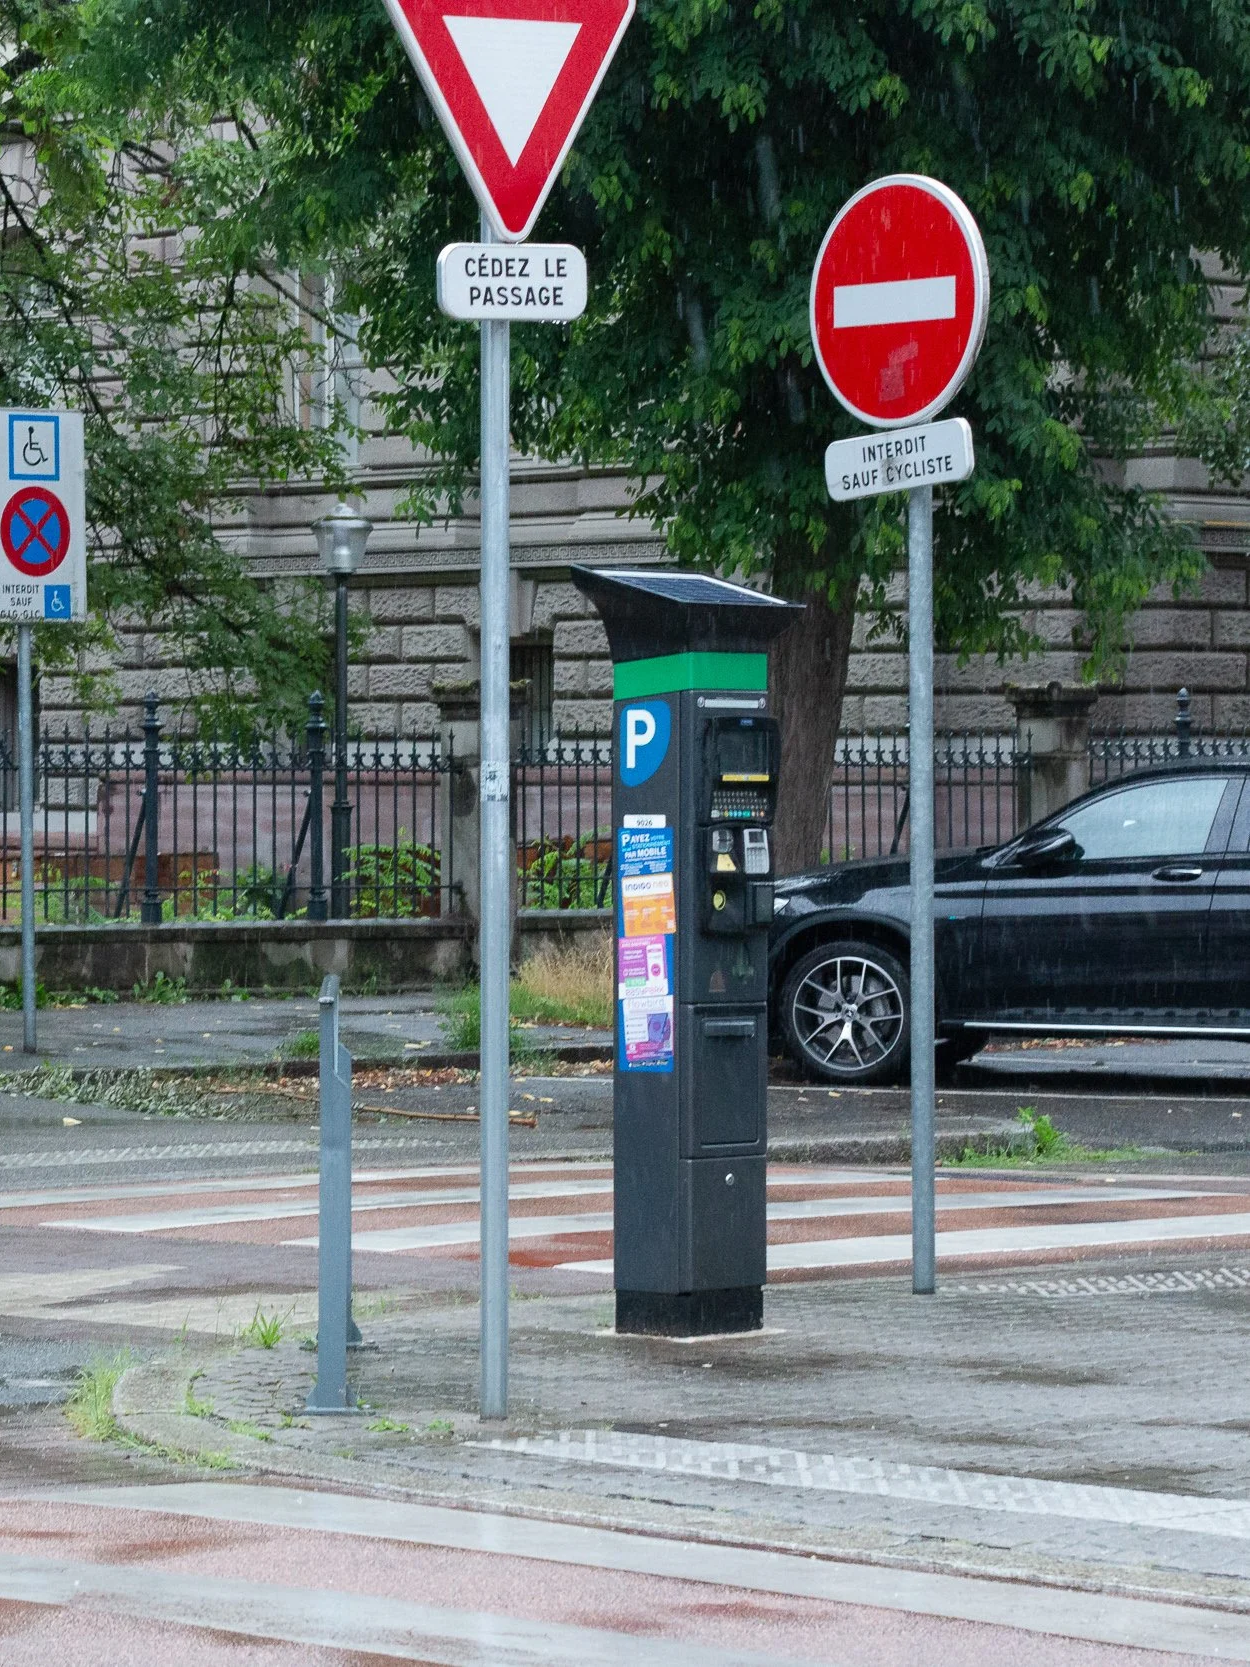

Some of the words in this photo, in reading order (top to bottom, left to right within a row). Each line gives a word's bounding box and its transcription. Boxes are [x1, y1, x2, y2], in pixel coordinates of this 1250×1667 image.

[465, 253, 529, 277] CÉDEZ
[545, 258, 567, 277] LE
[470, 286, 563, 306] PASSAGE
[862, 435, 926, 463] INTERDIT
[842, 469, 879, 490] SAUF
[886, 455, 953, 482] CYCLISTE
[2, 584, 40, 594] INTERDIT
[10, 597, 33, 607] SAUF
[627, 709, 656, 768] P
[621, 833, 650, 847] PAYEZ
[625, 851, 637, 859] PAR
[637, 846, 667, 858] MOBILE
